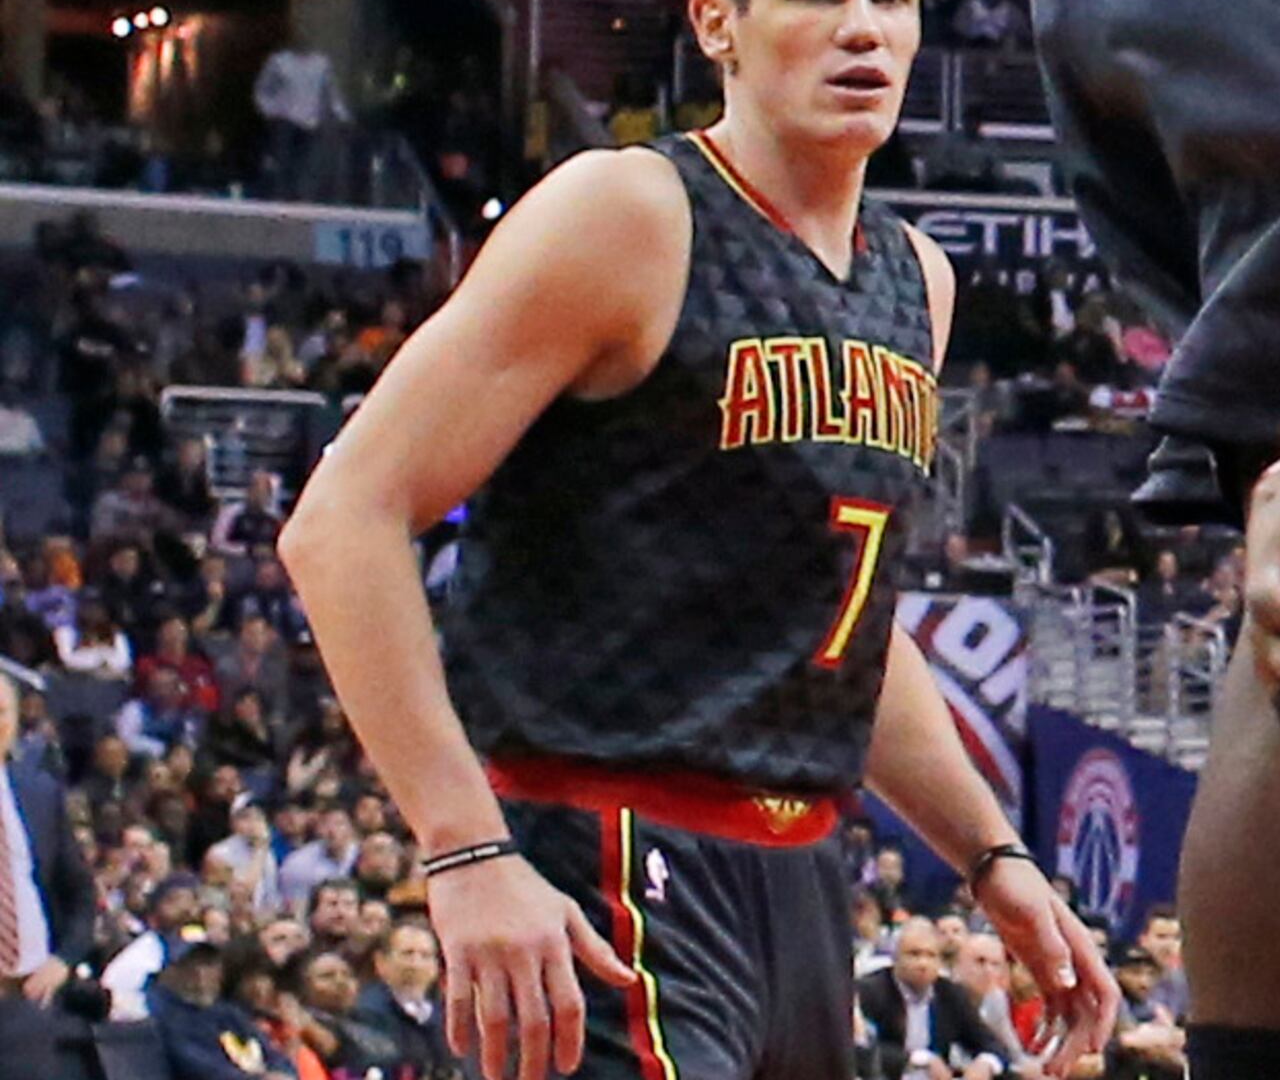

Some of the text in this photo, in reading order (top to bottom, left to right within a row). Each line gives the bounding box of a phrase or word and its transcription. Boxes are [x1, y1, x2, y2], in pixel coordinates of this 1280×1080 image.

[915, 209, 1096, 258] ETIH
[718, 336, 939, 478] ATLANT
[812, 493, 894, 669] 7
